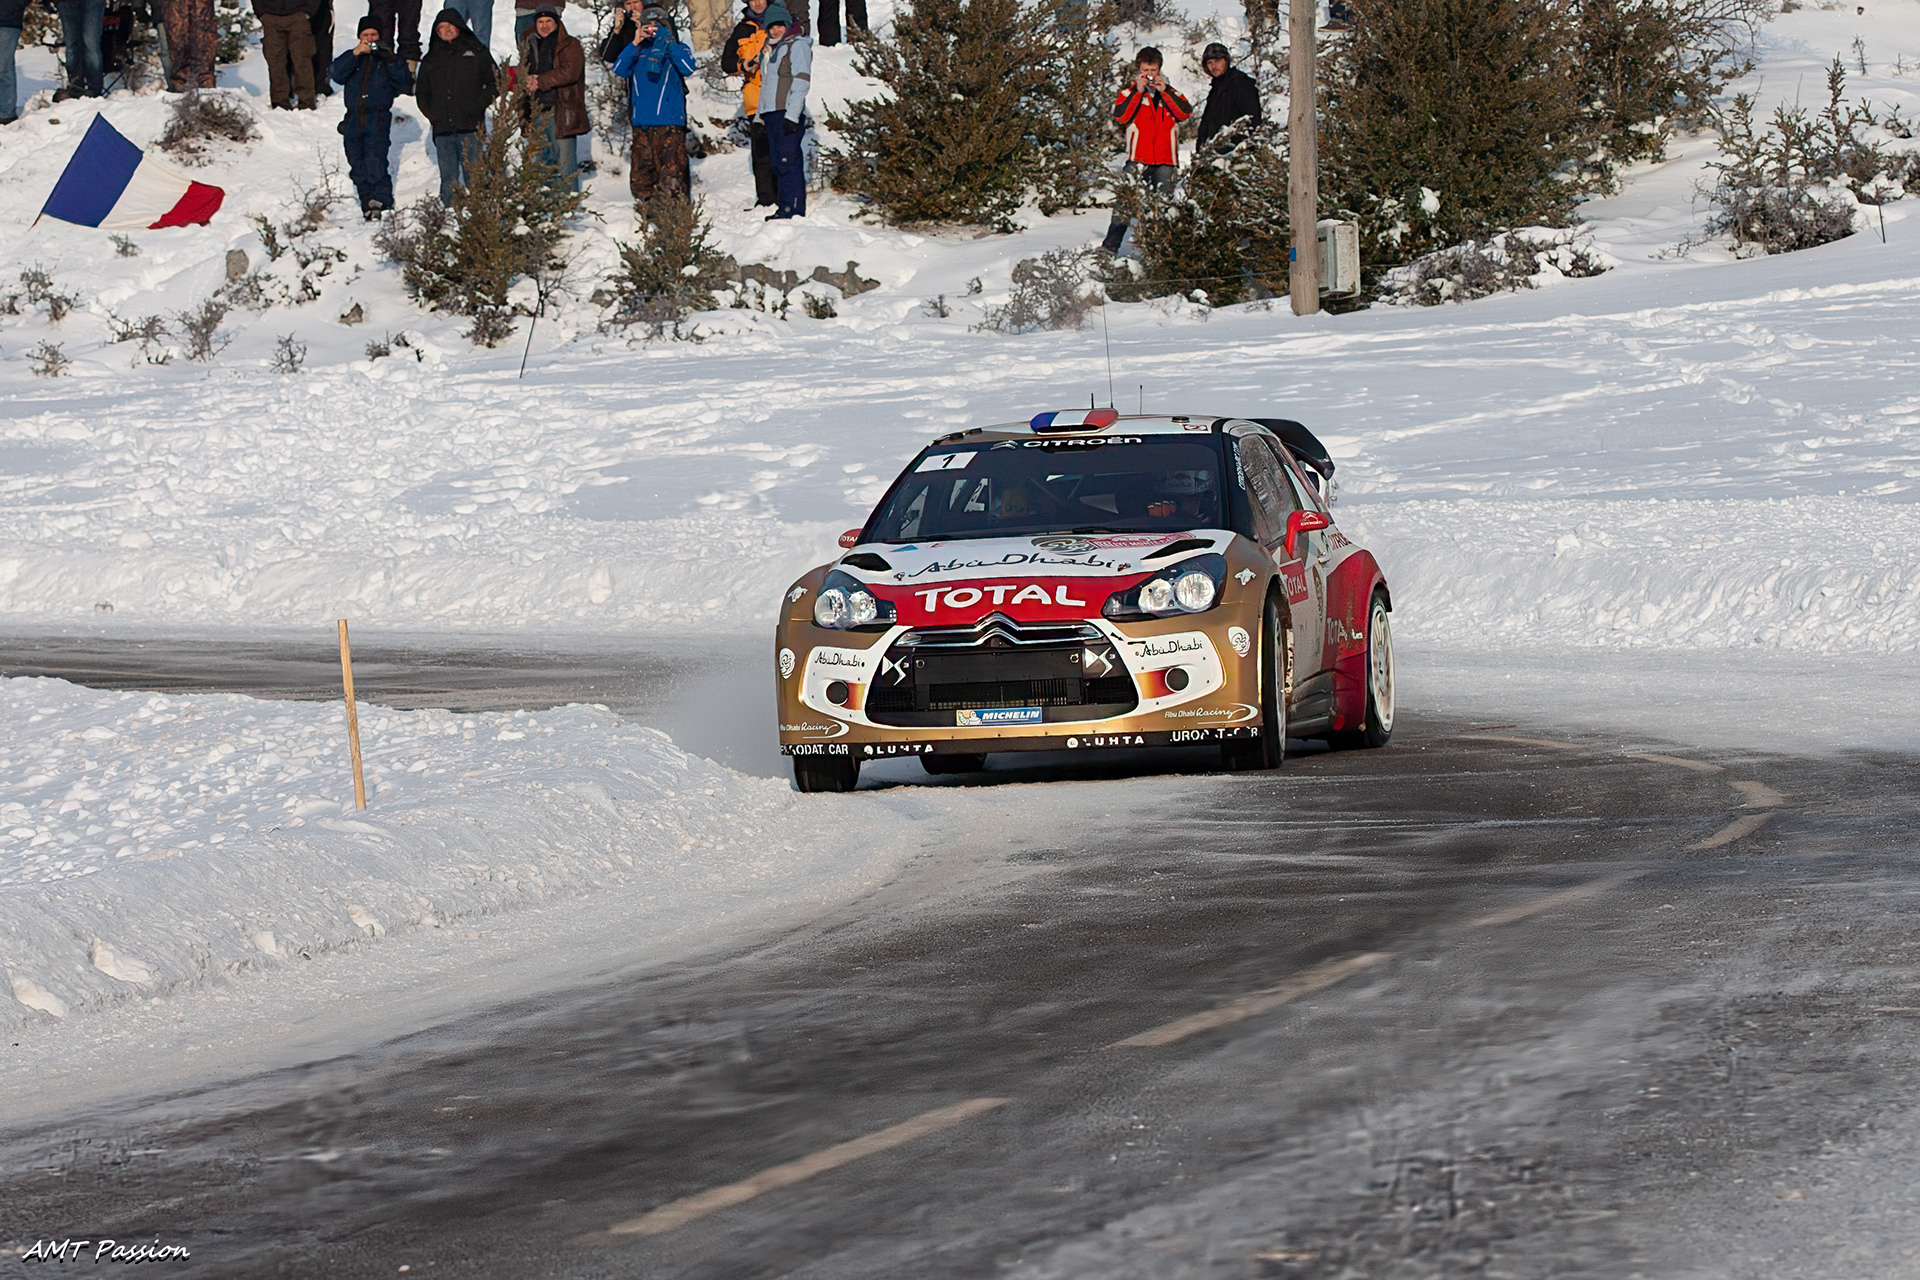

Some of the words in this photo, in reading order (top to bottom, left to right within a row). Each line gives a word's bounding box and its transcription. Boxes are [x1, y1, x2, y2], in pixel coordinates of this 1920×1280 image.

[1023, 437, 1142, 448] CITROËN
[942, 455, 957, 468] 1
[1282, 573, 1307, 597] TOTAL
[914, 584, 1086, 613] TOTAL
[982, 710, 1040, 720] MICHELIN
[1177, 710, 1196, 718] Dhabi
[1196, 707, 1246, 719] Racing
[801, 721, 838, 735] Racing
